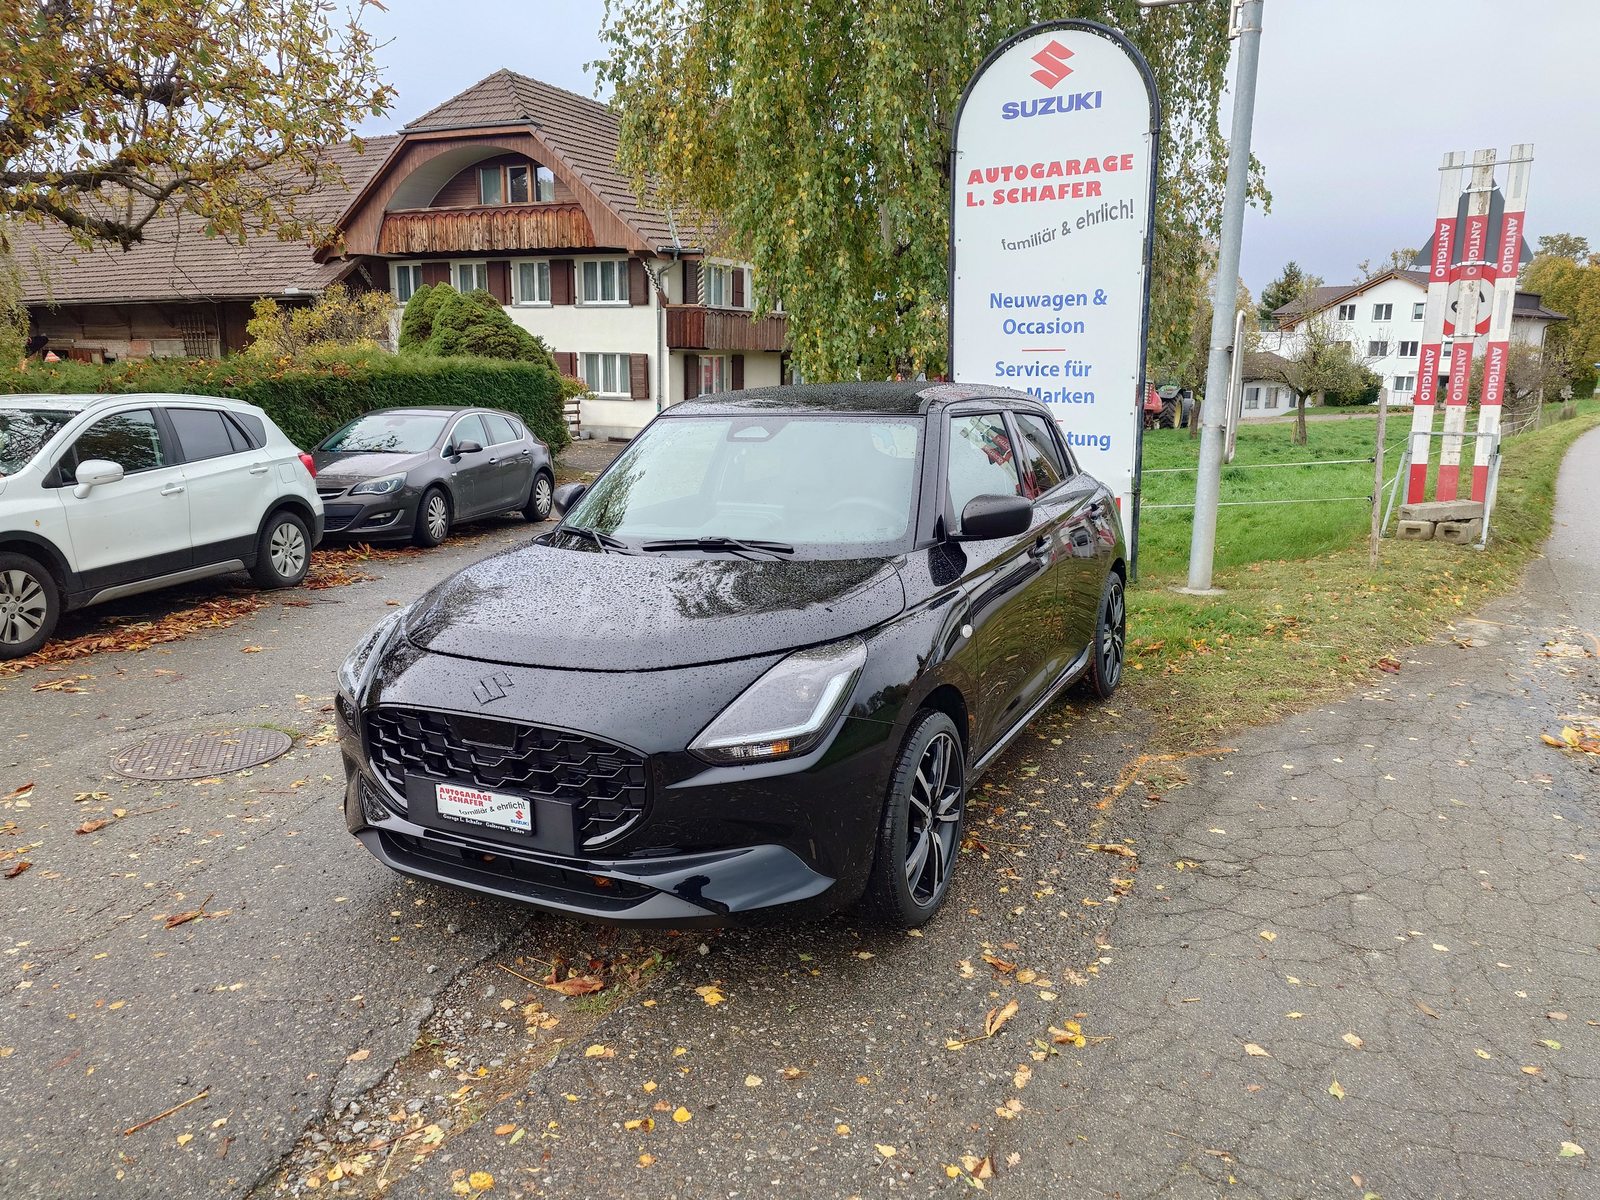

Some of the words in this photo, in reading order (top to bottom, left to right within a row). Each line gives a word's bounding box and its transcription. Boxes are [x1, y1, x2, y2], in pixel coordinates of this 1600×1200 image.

[1001, 90, 1102, 120] SUZUKI
[967, 153, 1134, 185] AUTOGARAGE
[966, 191, 985, 207] L.
[992, 180, 1102, 205] SCHAFER
[1001, 228, 1057, 251] familiär
[1061, 221, 1071, 236] &
[1076, 198, 1134, 230] ehrlich!
[1435, 223, 1451, 277] ANTIGLIO
[1502, 217, 1518, 274] ANTIGLIO
[989, 293, 1088, 311] Neuwagen
[1092, 288, 1108, 306] &
[1002, 317, 1085, 335] Occasion
[995, 360, 1060, 377] Service
[1064, 360, 1092, 377] für
[1420, 349, 1435, 401] ANTIGLIO
[1452, 348, 1467, 401] ANTIGLIO
[1487, 346, 1502, 400] ANTIGLIO
[439, 787, 493, 802] AUTOGARAGE
[448, 795, 484, 807] SCHAFER
[496, 801, 526, 811] ehrlich!
[510, 819, 530, 827] SUZUKI
